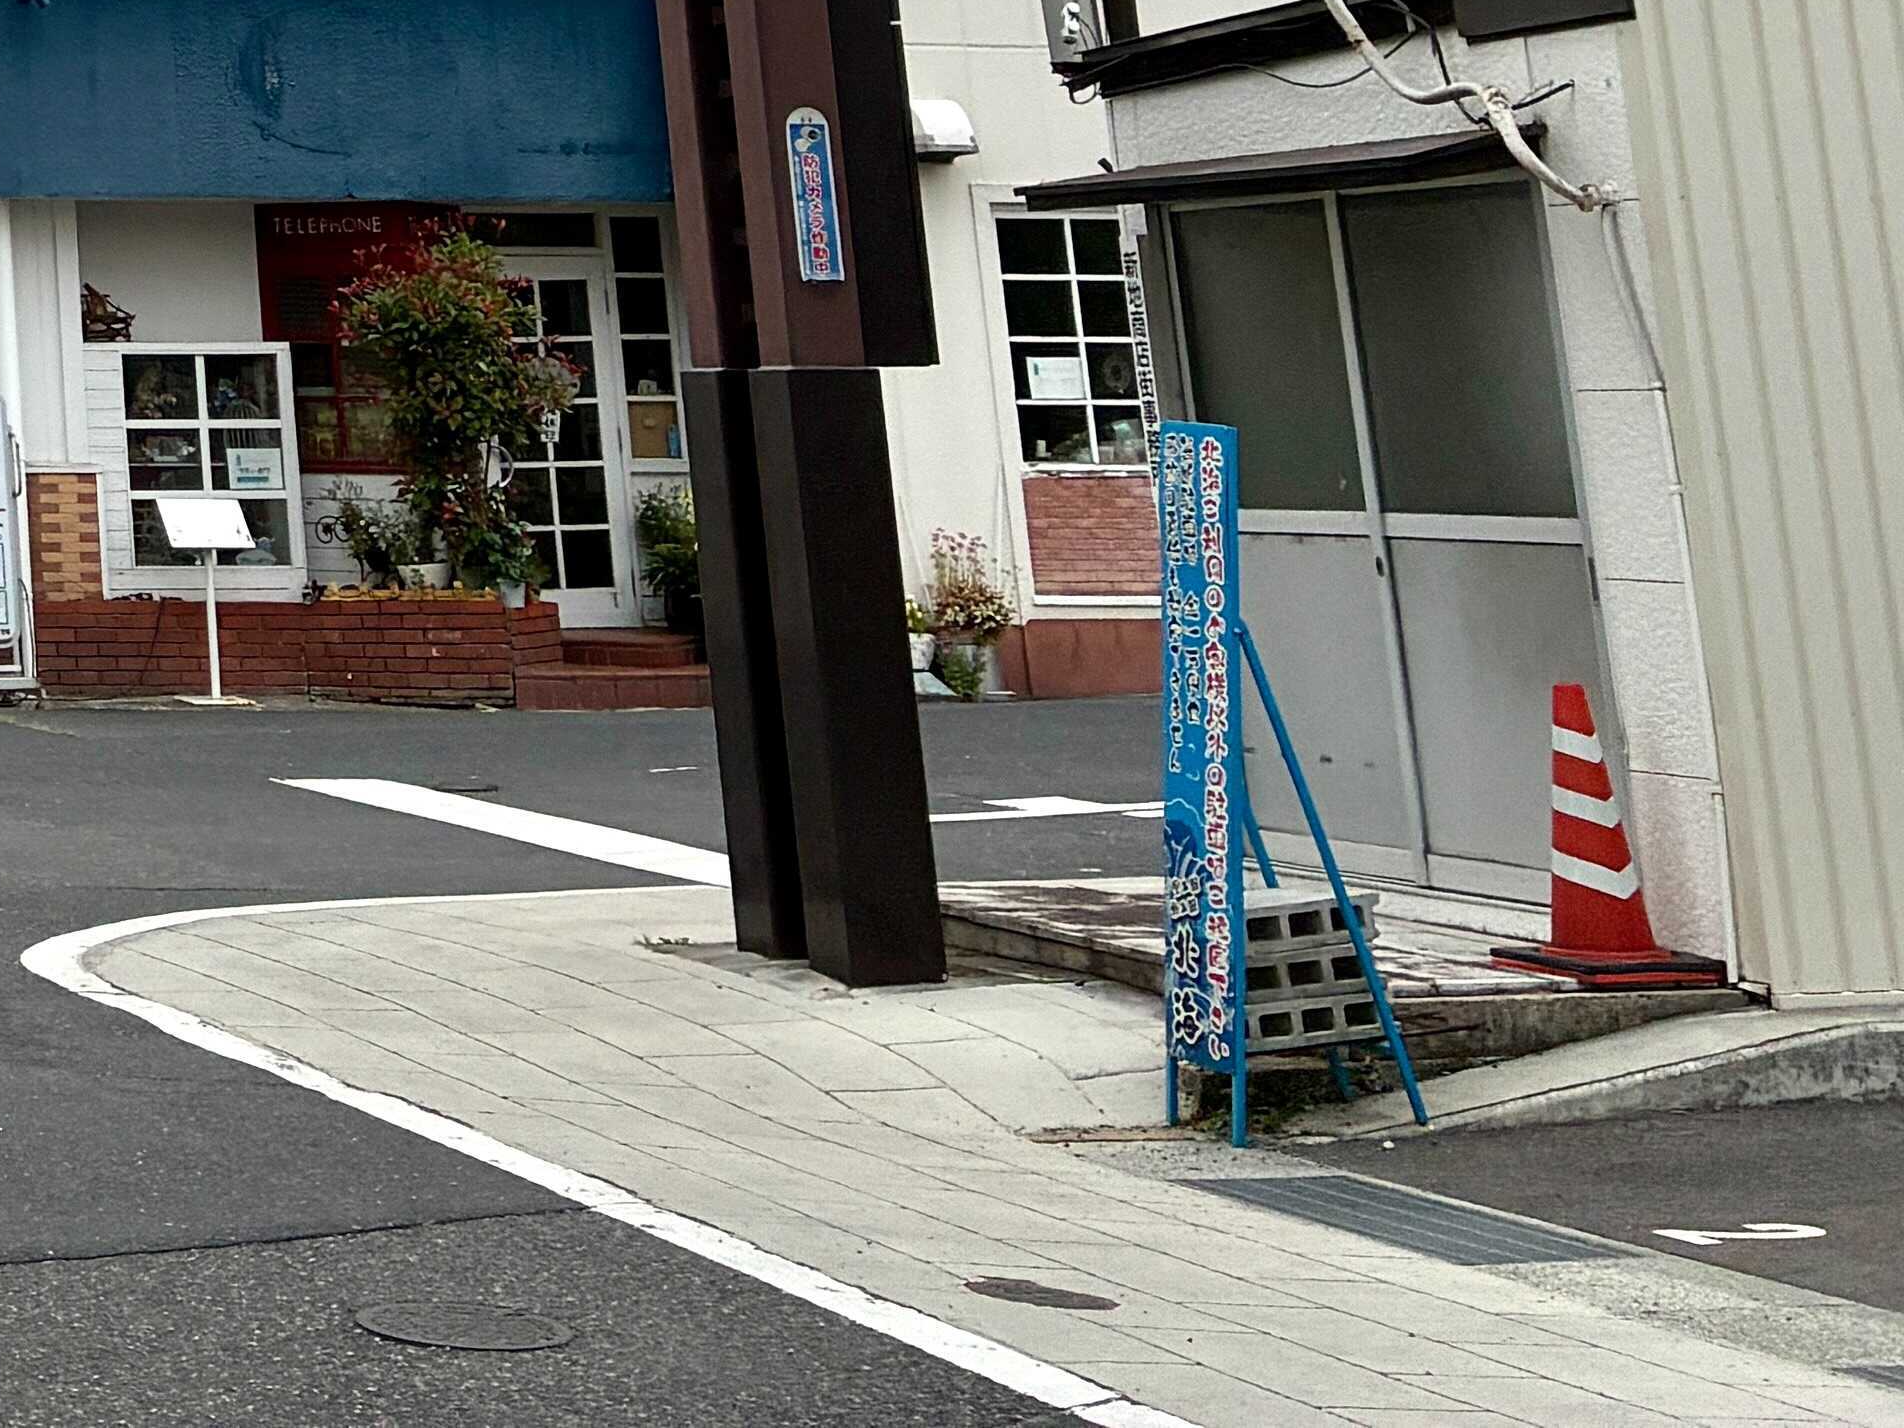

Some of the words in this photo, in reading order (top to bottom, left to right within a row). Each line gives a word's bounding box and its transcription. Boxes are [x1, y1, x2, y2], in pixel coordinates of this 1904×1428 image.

[273, 216, 383, 235] TELEPHONE
[801, 153, 831, 274] 防犯カメラ作動中
[1652, 1222, 1828, 1246] 2
